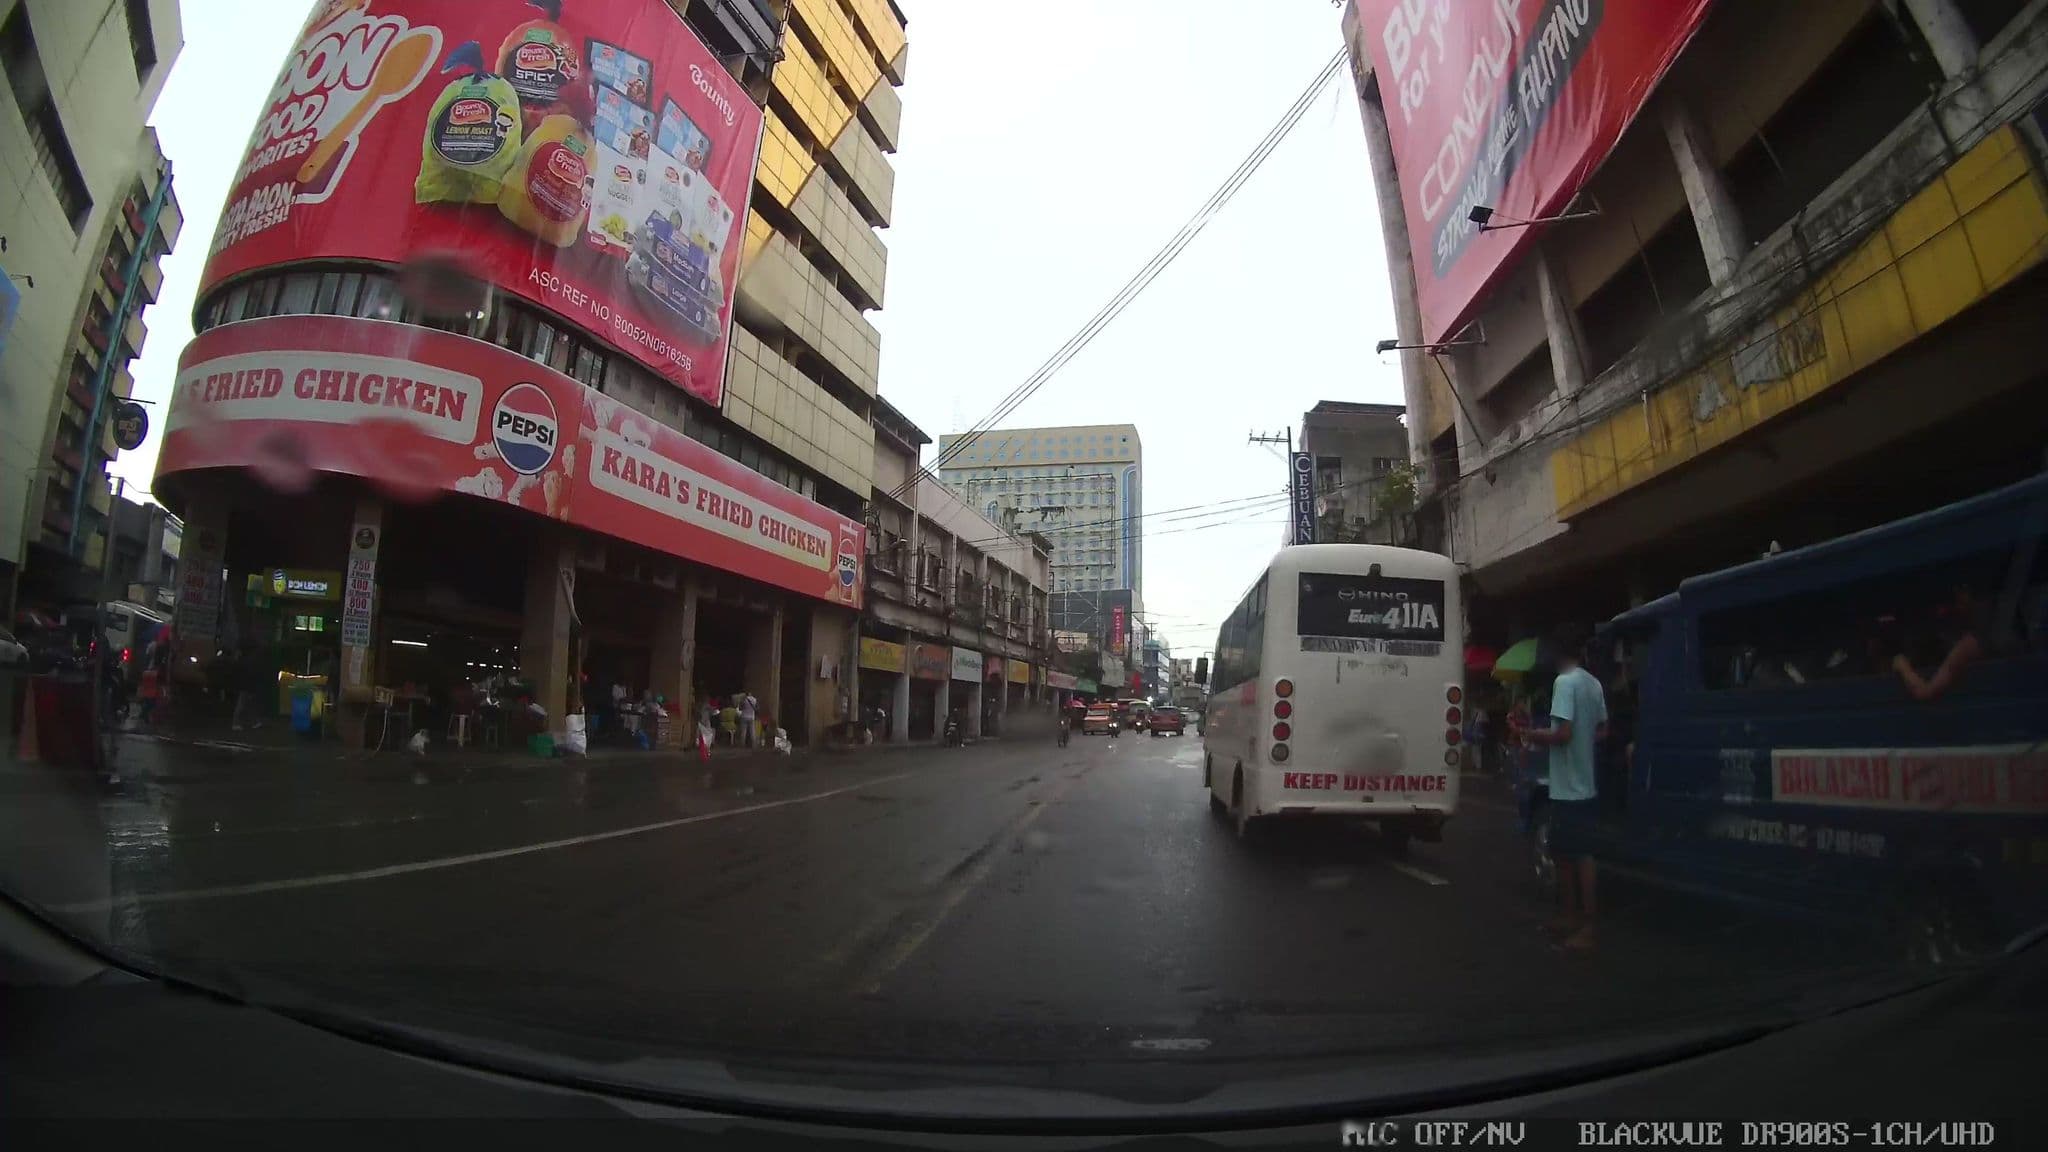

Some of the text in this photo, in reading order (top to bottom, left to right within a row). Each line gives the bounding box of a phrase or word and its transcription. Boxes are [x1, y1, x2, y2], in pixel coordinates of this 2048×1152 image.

[516, 69, 556, 82] SPICY
[689, 63, 736, 127] Bounty
[239, 206, 290, 241] FRESH!
[528, 268, 560, 292] ASC
[562, 284, 589, 309] REF
[203, 368, 285, 402] FRIED
[293, 368, 469, 422] CHICKEN
[497, 410, 555, 447] PEPSI
[602, 446, 827, 559] KARA'S FRIED CHICKEN
[838, 553, 857, 571] PEPSI
[1359, 590, 1409, 600] HINO
[1284, 772, 1448, 793] KEEP DISTANCE
